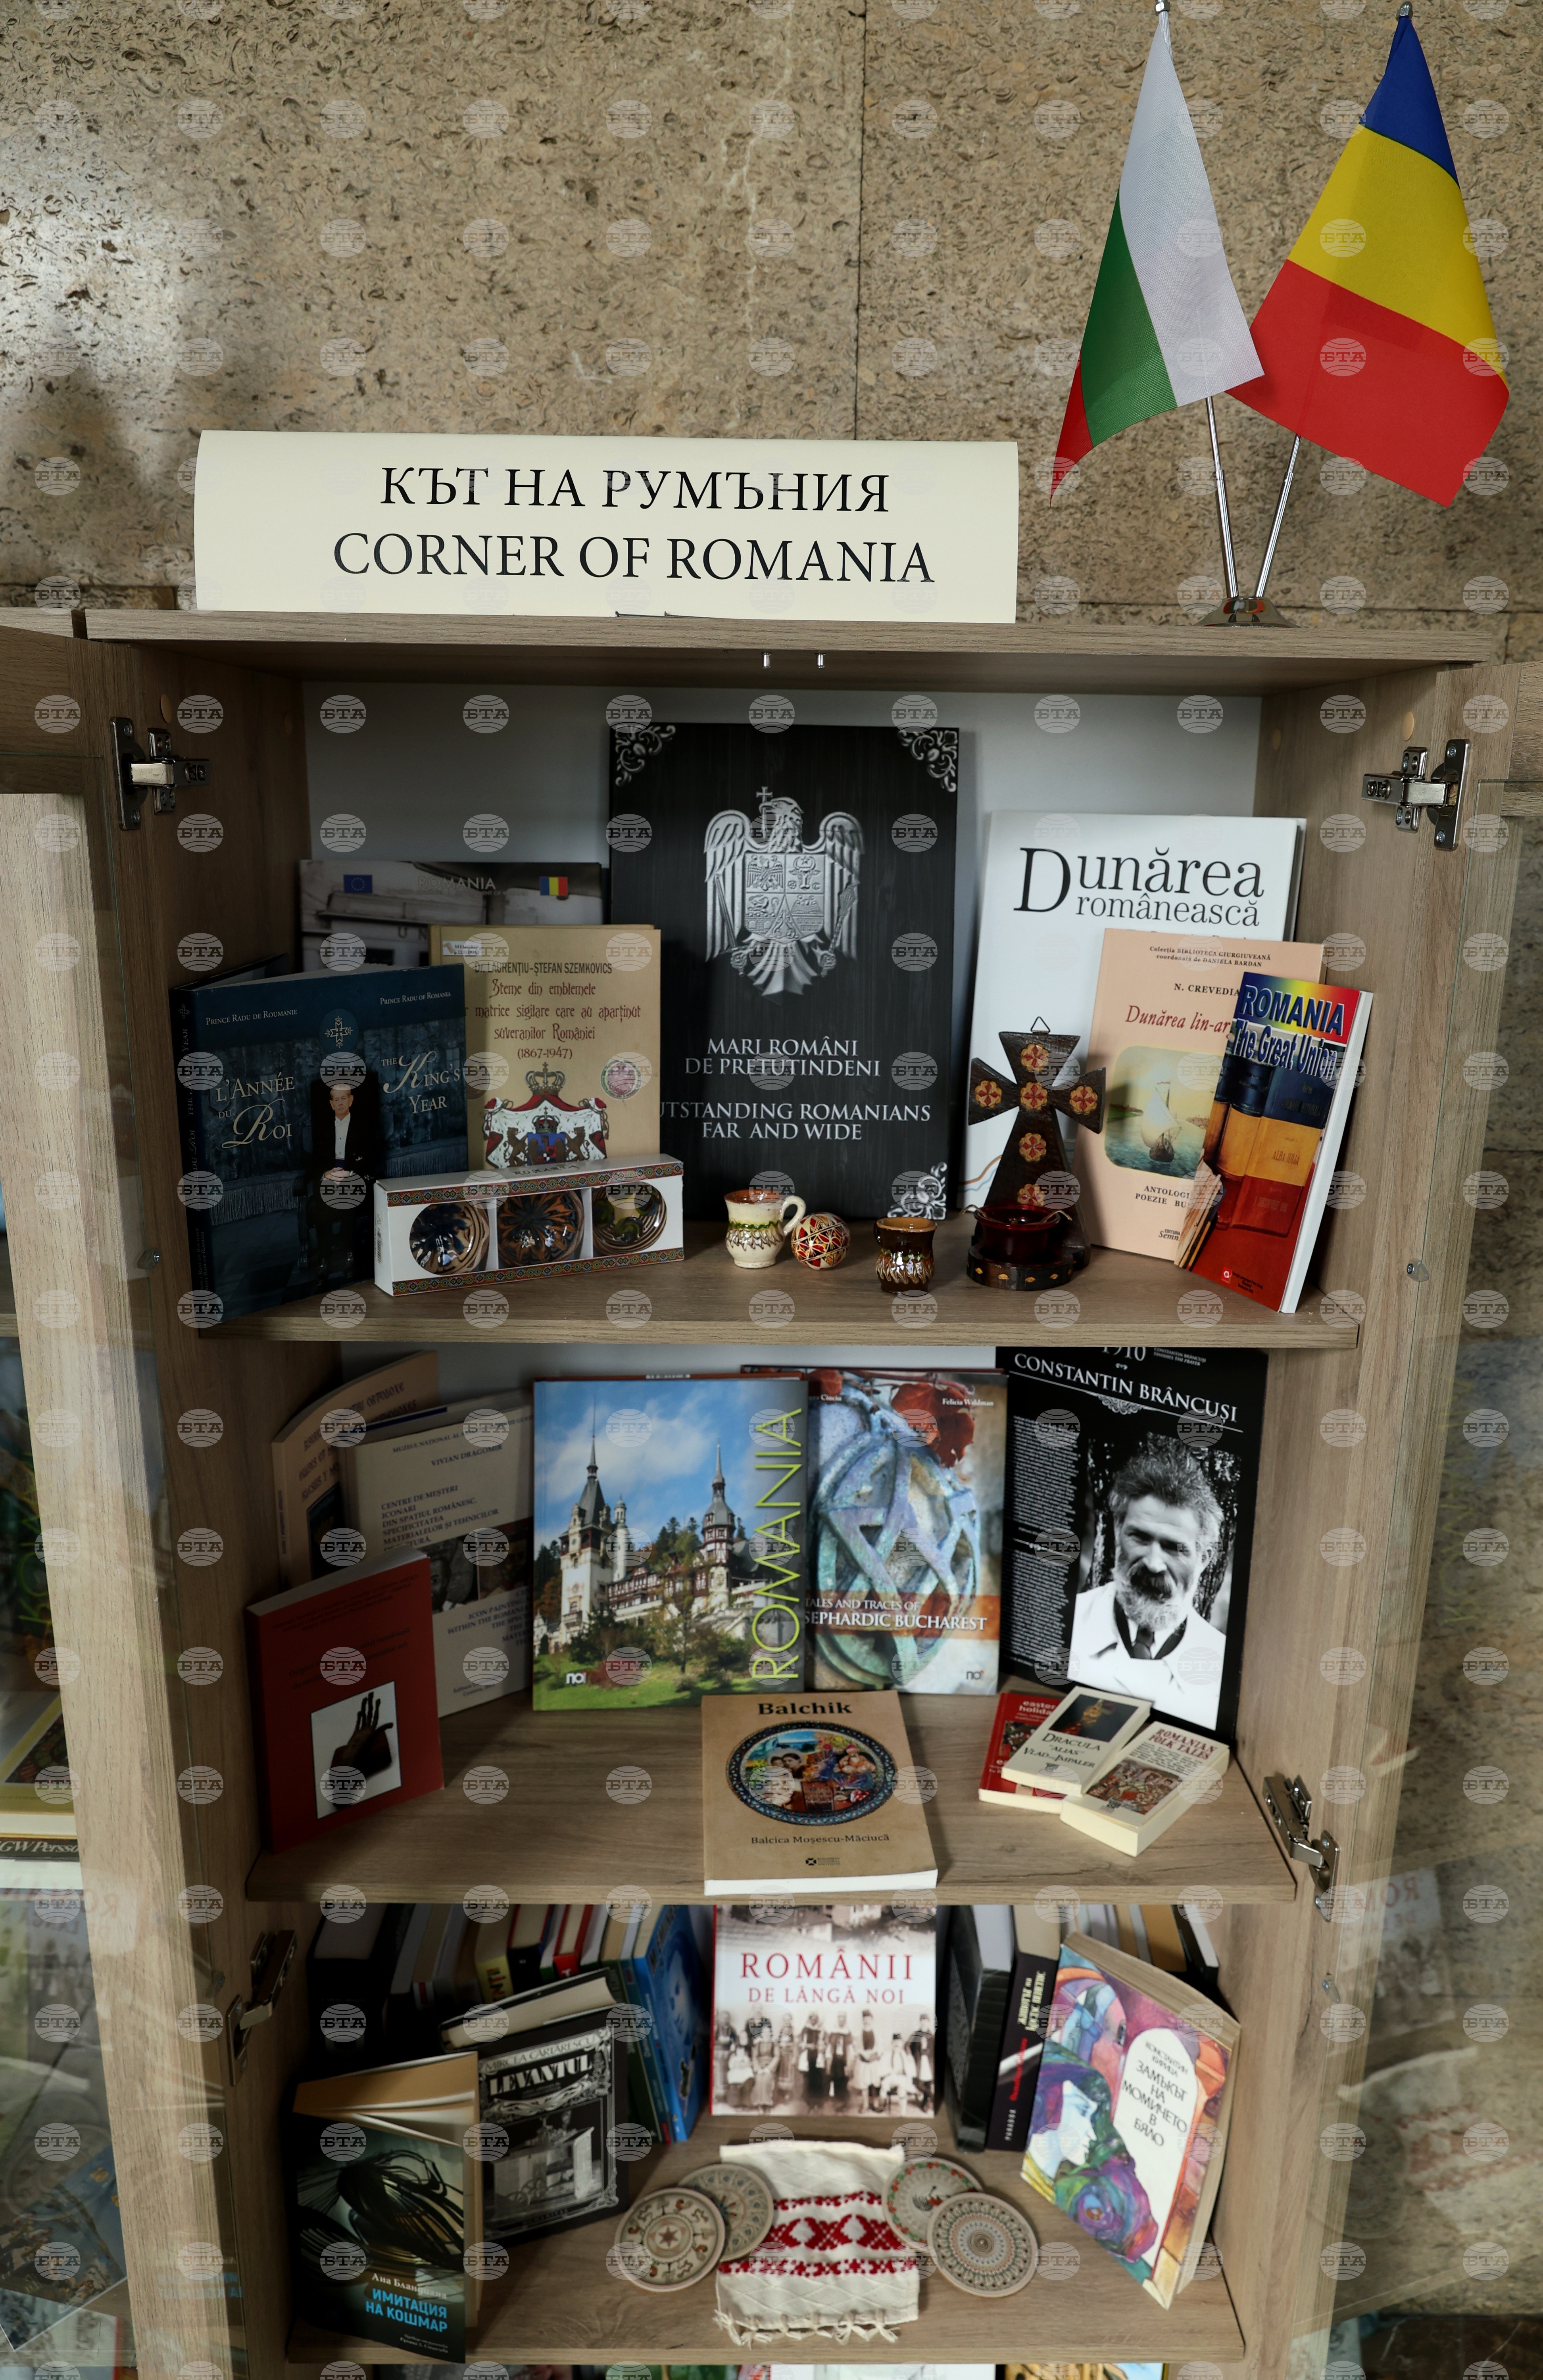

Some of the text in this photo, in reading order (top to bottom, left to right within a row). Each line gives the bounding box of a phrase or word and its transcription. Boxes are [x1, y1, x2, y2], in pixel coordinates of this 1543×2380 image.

[380, 467, 890, 513] КЪТ НА РУМЪНИЯ
[333, 532, 935, 583] CORNER OF ROMANIA
[418, 877, 496, 889] ROMANIA
[1013, 846, 1264, 913] Dunărea
[1075, 893, 1260, 927] românească
[1177, 948, 1216, 956] BIBLIOTECA
[1219, 951, 1271, 960] GIURGIUVEANĂ
[565, 963, 612, 974] SZEMKOVICS
[489, 979, 596, 998] Steme din emblemele
[1188, 984, 1239, 996] CREVEDIA
[476, 1005, 509, 1017] matrice
[517, 1005, 549, 1020] sigilare
[555, 1007, 575, 1017] care
[1239, 985, 1344, 1036] ROMANIA
[1125, 1005, 1232, 1039] Dunărea lin-ar
[553, 1023, 595, 1042] României
[518, 1047, 572, 1060] (1867-1947)
[707, 1036, 858, 1057] MARI ROMÂNI
[1233, 1018, 1337, 1081] The Great Union
[685, 1058, 881, 1077] DE PRETUTINDENI
[660, 1102, 931, 1121] TSTANDING ROMANIANS
[702, 1122, 862, 1140] FAR AND WIDE
[1135, 1193, 1167, 1205] POEZIE
[1144, 1186, 1189, 1199] ANTOLOGI
[1159, 1230, 1180, 1241] Semn
[1014, 1353, 1237, 1424] CONSTANTIN BRÂNCUȘI
[431, 1444, 502, 1466] VIVIAN DRAGOMIR
[381, 1497, 411, 1509] CENTRE
[382, 1505, 417, 1518] ICONARI
[383, 1518, 398, 1528] DIN
[383, 1525, 443, 1545] MATERIALELOR
[454, 1509, 498, 1526] TEHNICILOR
[752, 1407, 802, 1679] ROMANIA
[805, 1597, 918, 1611] TALES AND TRACES OF
[804, 1611, 987, 1631] SEPHARDIC BUCHAREST
[566, 1672, 587, 1685] noi
[758, 1702, 853, 1715] Balchik
[1019, 1706, 1052, 1715] holida
[1023, 1701, 1056, 1709] easter
[1148, 1735, 1174, 1748] FOLK
[1177, 1745, 1209, 1760] TALES
[1156, 1729, 1217, 1753] ROMANIAN
[751, 1836, 790, 1844] Balcica
[740, 1948, 913, 1980] ROMÂNII
[749, 1986, 904, 2004] DE LÂNGĂ NOI
[490, 2054, 592, 2096] LEVANTUL
[1136, 2059, 1187, 2101] ЗАМЪКЪТ
[1151, 2084, 1165, 2103] НА
[1122, 2080, 1187, 2132] МОМИЧЕТО
[1149, 2113, 1157, 2126] В
[1134, 2117, 1164, 2146] БЯЛО
[372, 2273, 447, 2299] Ана Бландиана
[372, 2288, 447, 2319] ИМИТАЦИЯ
[365, 2301, 448, 2333] НА КОШМАР
